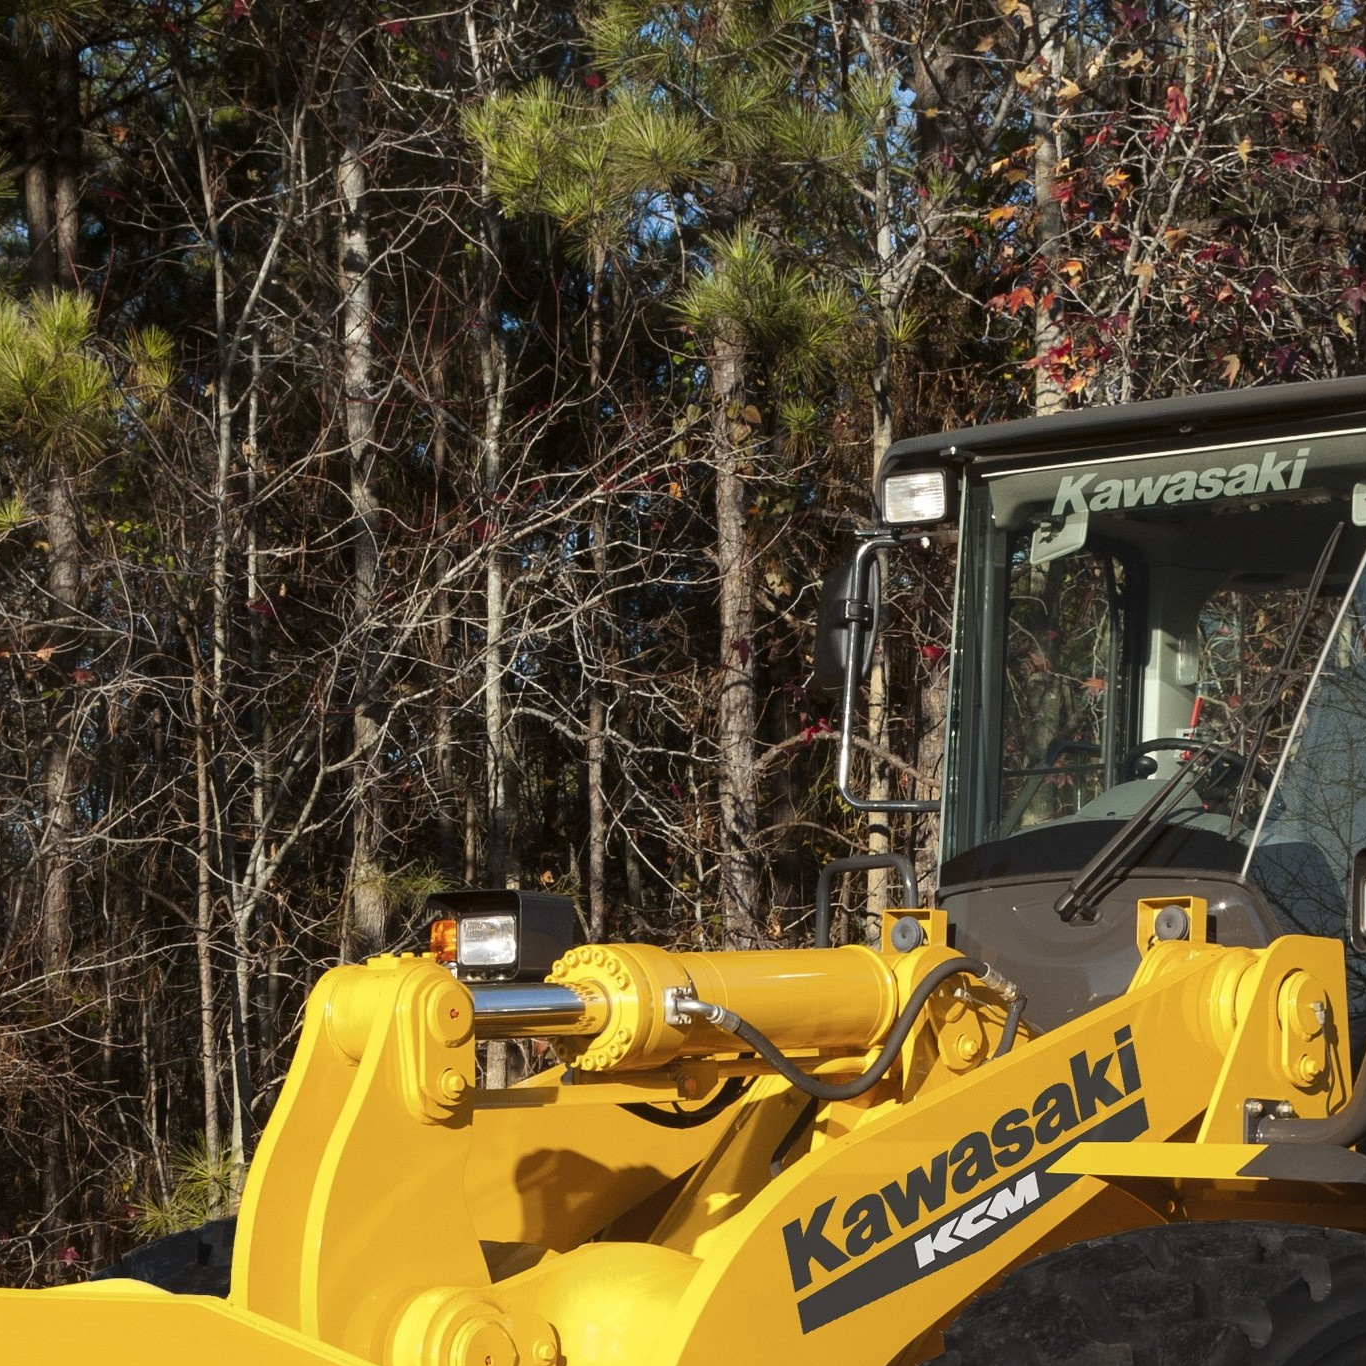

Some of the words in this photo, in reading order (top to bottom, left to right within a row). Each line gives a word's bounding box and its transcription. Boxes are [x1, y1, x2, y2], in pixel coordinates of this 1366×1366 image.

[1051, 448, 1310, 516] Kawasaki
[782, 1024, 1142, 1292] Kawasaki
[914, 1172, 1040, 1269] KCM
